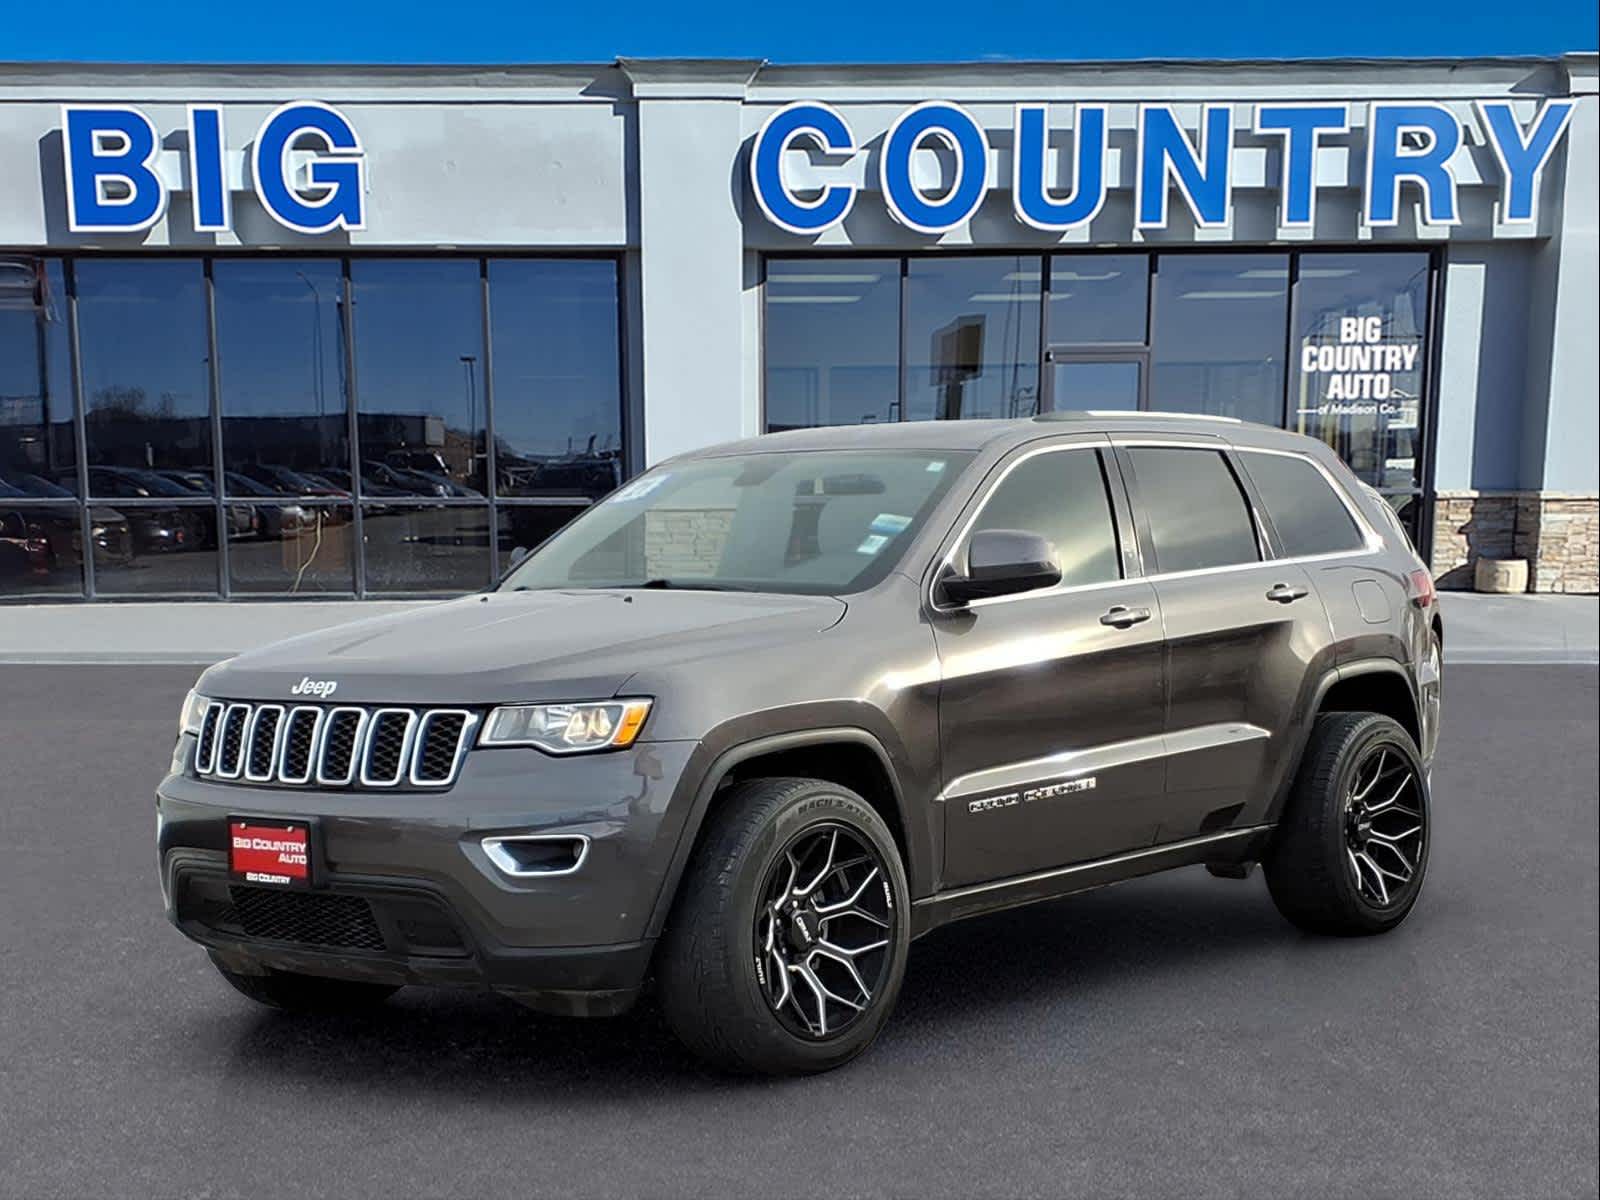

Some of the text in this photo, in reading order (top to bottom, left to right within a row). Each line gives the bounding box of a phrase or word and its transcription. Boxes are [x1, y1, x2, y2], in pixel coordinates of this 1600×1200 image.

[60, 99, 1575, 236] BIG COUNTRY
[1340, 316, 1382, 343] BIG
[1302, 344, 1418, 372] COUNTRY
[1327, 373, 1390, 399] AUTO
[1318, 404, 1330, 415] of
[1330, 404, 1377, 415] Madison
[292, 677, 337, 698] Jeep
[252, 838, 306, 853] COUNTRY
[278, 853, 307, 865] AUTO
